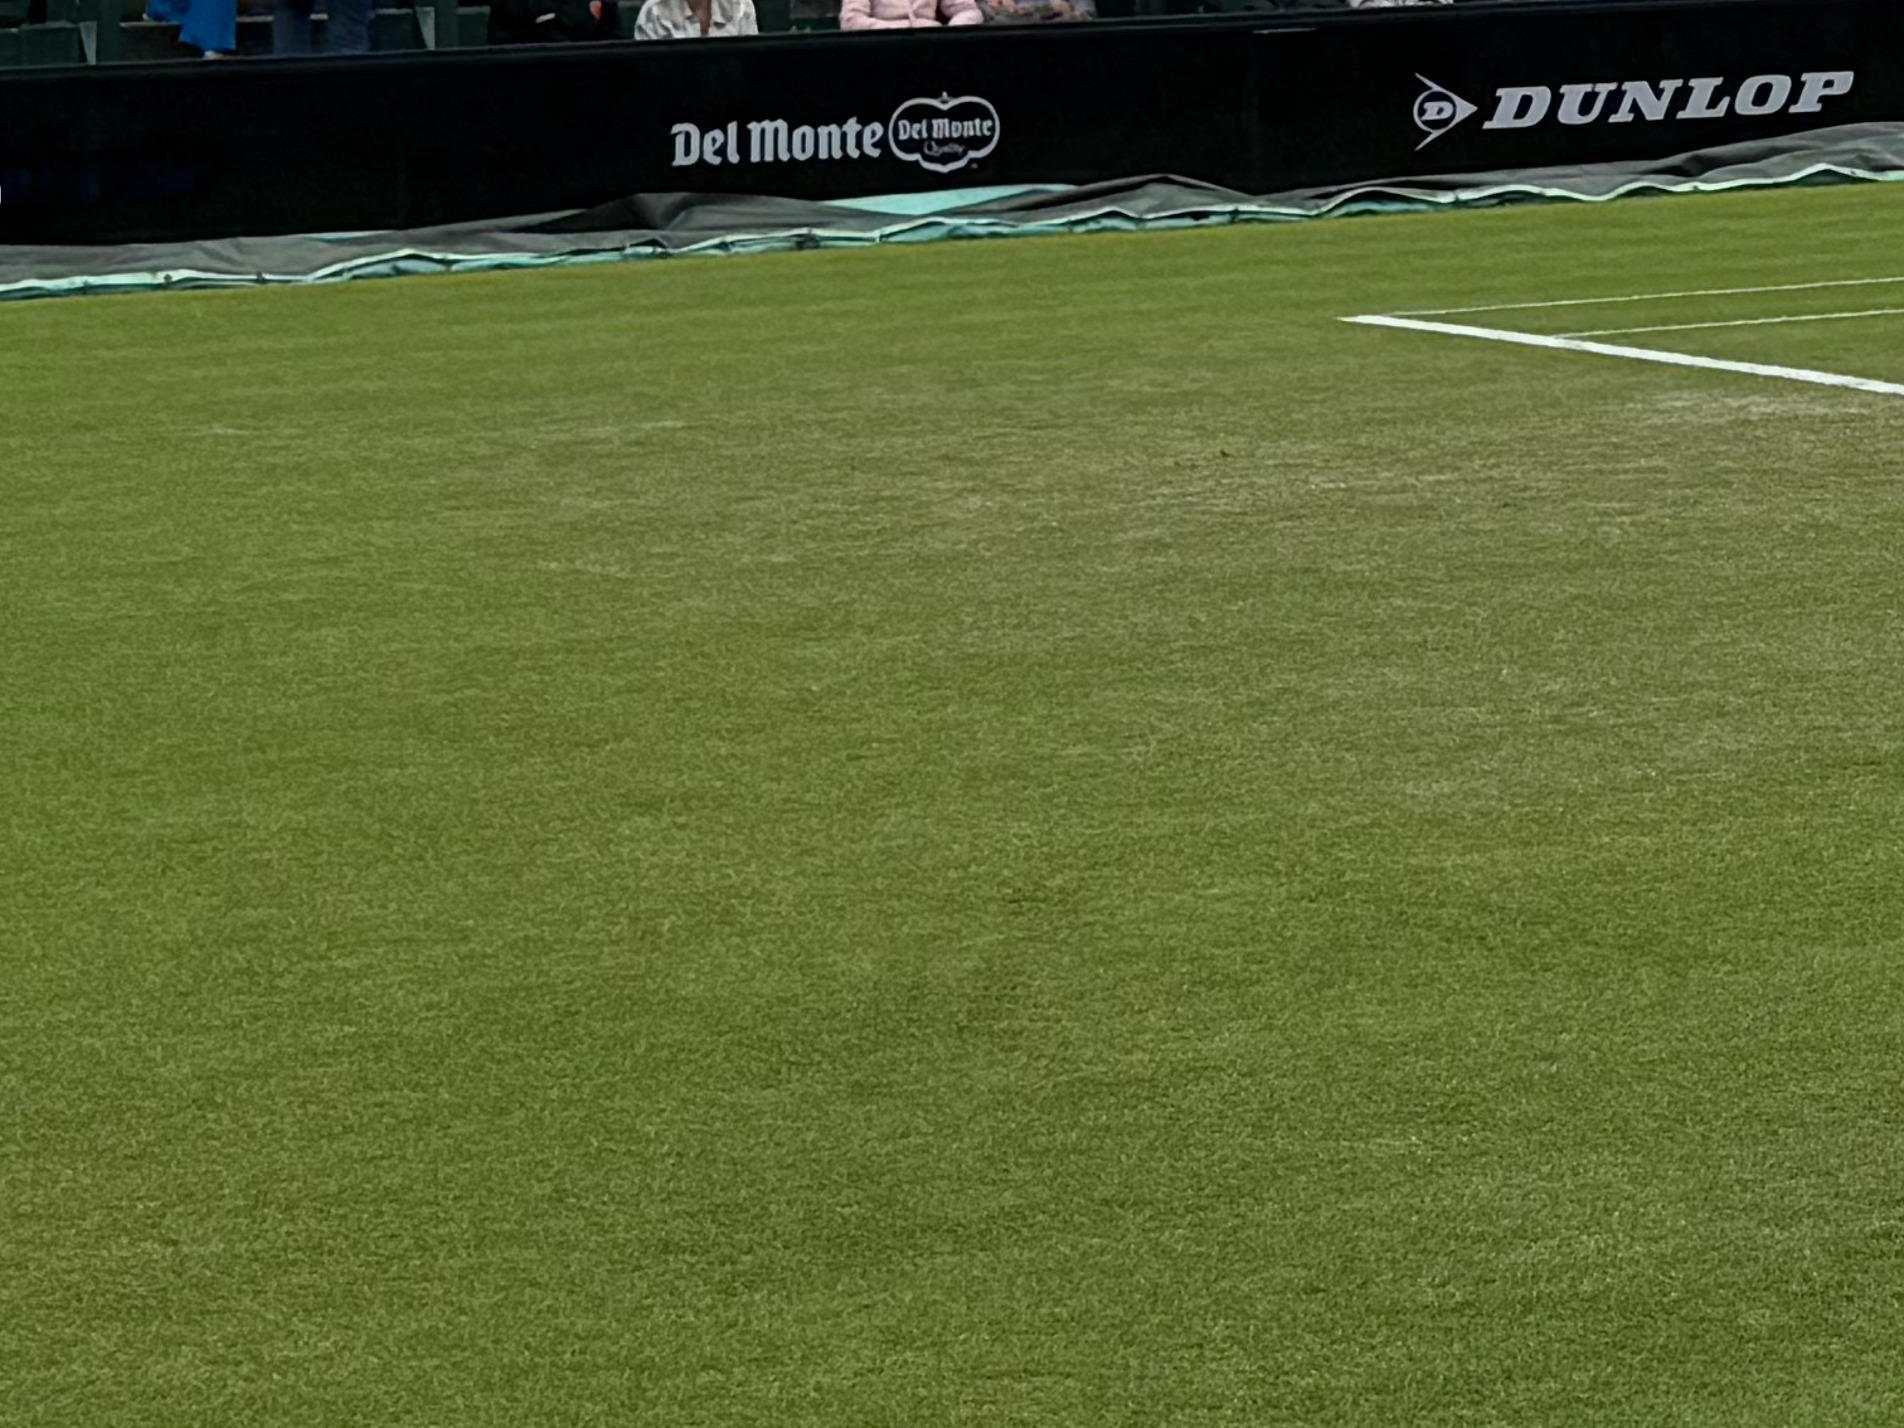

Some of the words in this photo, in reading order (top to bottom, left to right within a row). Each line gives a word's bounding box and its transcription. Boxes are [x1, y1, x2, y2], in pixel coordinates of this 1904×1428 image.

[1481, 70, 1855, 130] DUNLOP
[670, 120, 740, 167] Del
[746, 116, 884, 163] Monte
[898, 118, 928, 140] Del
[931, 117, 993, 140] Monte
